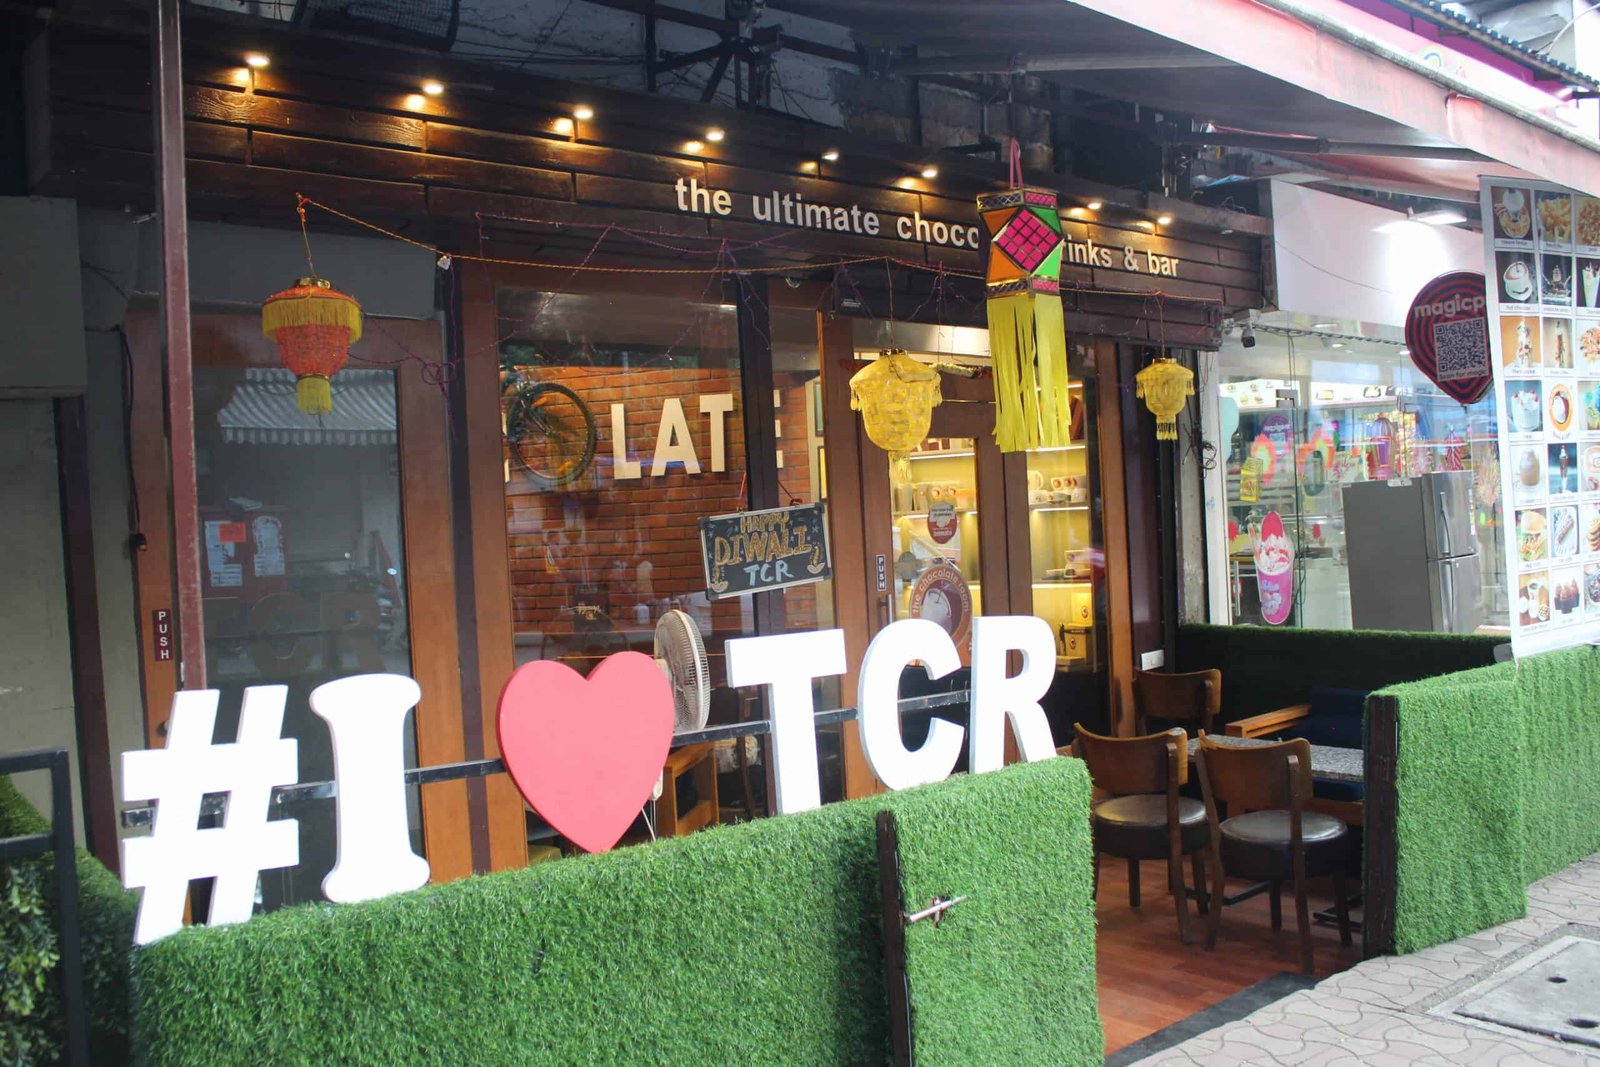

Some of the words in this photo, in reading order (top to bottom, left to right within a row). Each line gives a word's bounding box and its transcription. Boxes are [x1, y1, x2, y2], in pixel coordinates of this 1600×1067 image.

[675, 177, 733, 216] the
[752, 190, 881, 237] ultimate
[895, 210, 980, 250] choco
[1063, 233, 1113, 268] inks
[1124, 245, 1139, 271] &
[1147, 249, 1180, 277] bar
[1414, 293, 1486, 319] magicp
[740, 511, 790, 535] HAPPY
[714, 525, 813, 566] DIWALI
[743, 560, 795, 586] TCR
[158, 610, 170, 660] PUSH
[724, 615, 1058, 815] TCR
